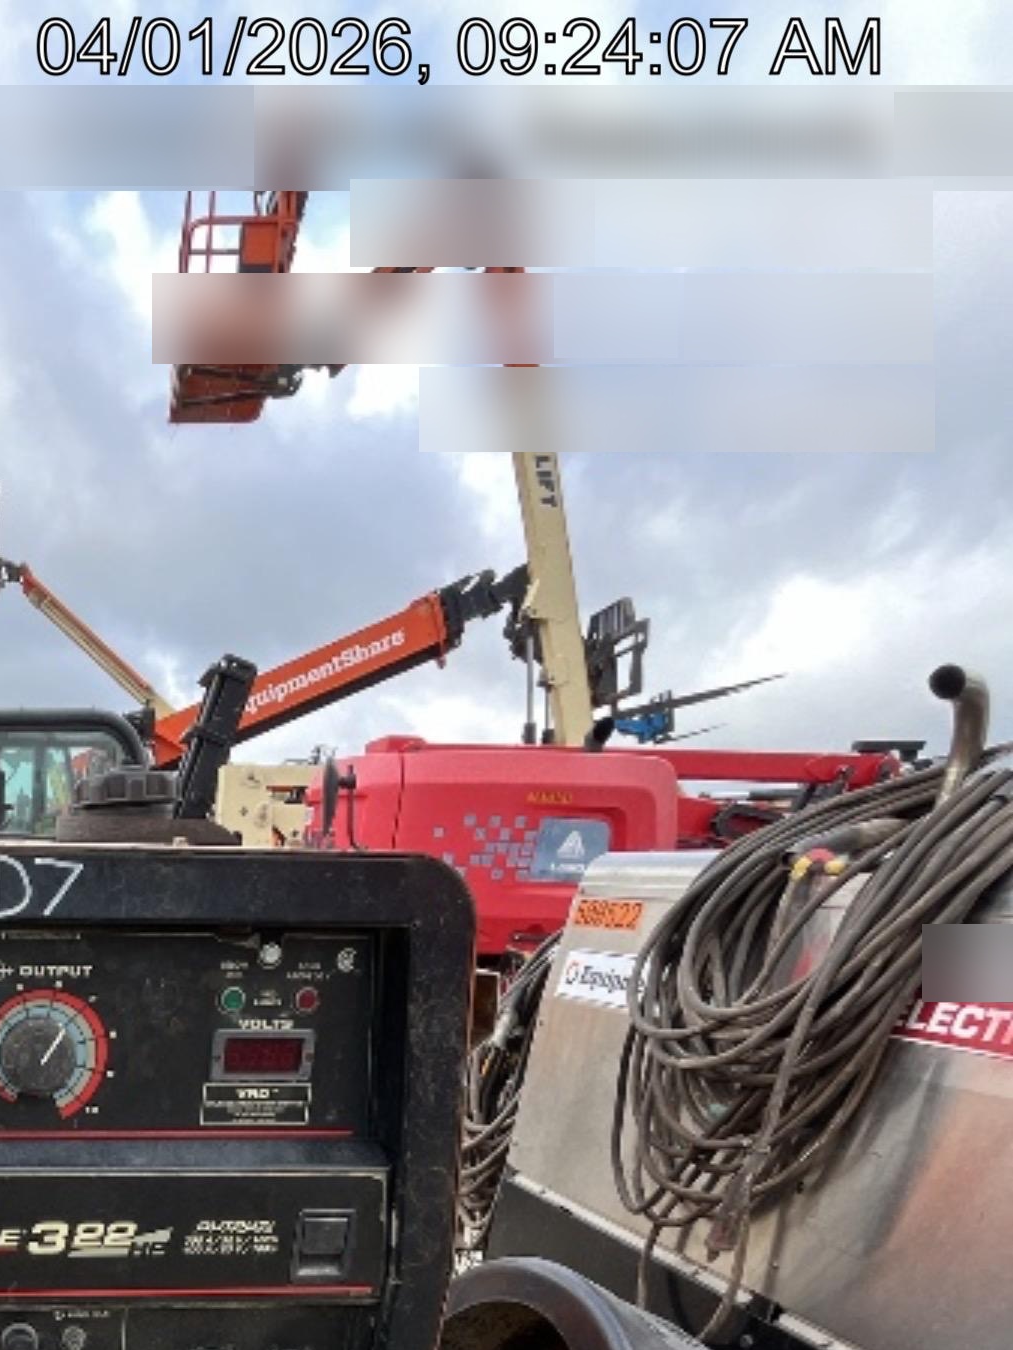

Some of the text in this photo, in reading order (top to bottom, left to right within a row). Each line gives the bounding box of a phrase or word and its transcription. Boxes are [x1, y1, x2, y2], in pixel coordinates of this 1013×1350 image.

[535, 455, 558, 508] LIFT
[244, 628, 406, 714] quipmentShare
[19, 965, 93, 978] OUTPUT
[892, 999, 1013, 1045] LECT
[28, 1220, 138, 1255] 322
